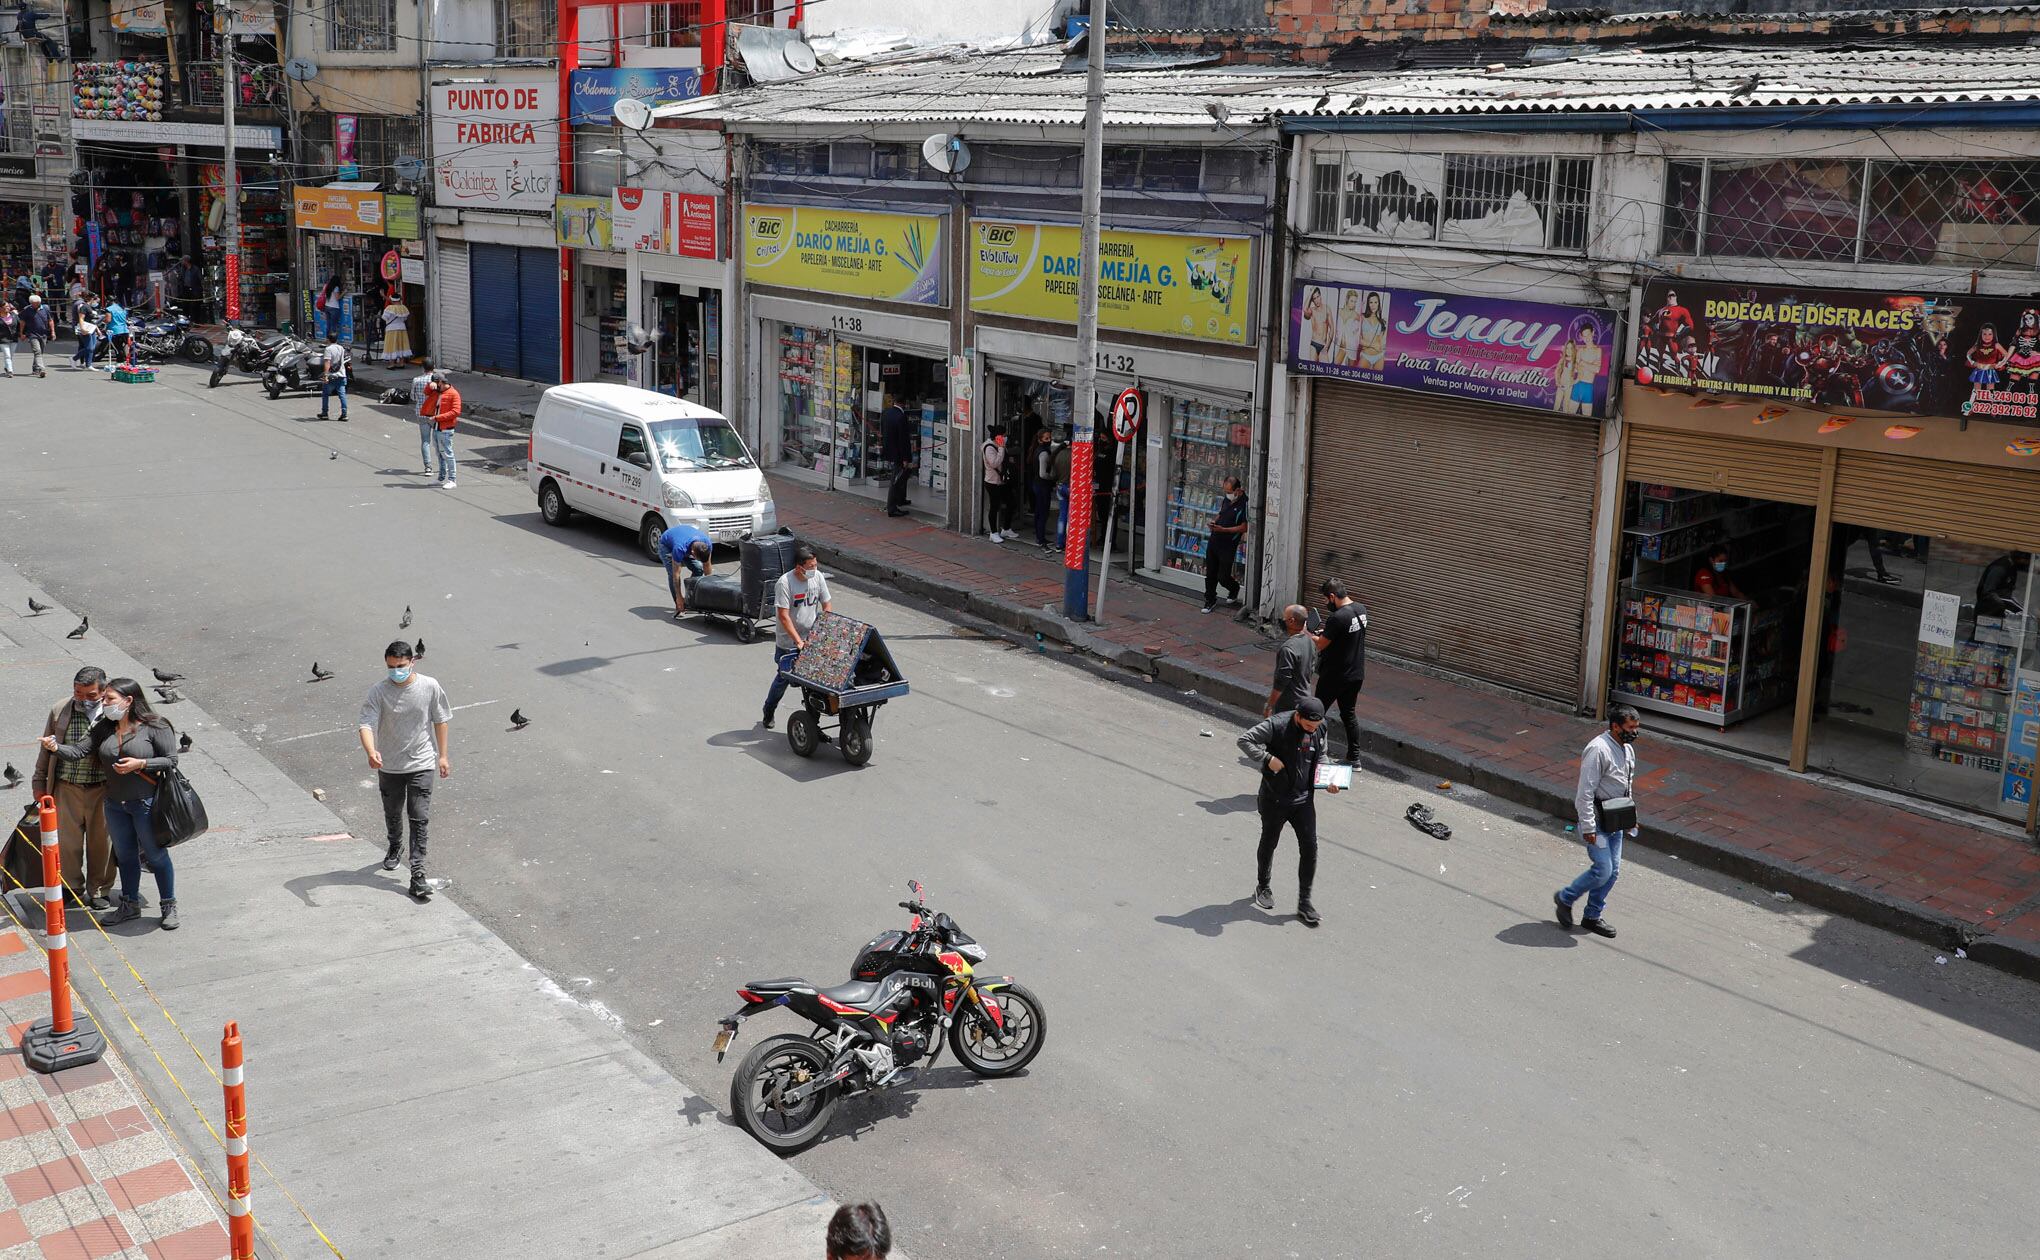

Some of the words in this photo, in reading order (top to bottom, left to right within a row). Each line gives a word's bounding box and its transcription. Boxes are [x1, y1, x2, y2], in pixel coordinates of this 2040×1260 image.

[574, 77, 616, 96] Adornos
[448, 89, 511, 111] PUNTO
[517, 88, 538, 110] DE
[457, 123, 536, 145] FABRICA
[797, 229, 832, 250] DARÍO
[836, 232, 871, 255] MEJÍA
[875, 238, 888, 256] G.
[801, 251, 827, 267] PAPELERÍA
[868, 258, 882, 272] ARTE
[1043, 252, 1081, 276] DARÍ
[1101, 257, 1151, 284] MEJÍA
[1158, 265, 1177, 287] G.
[1045, 279, 1080, 297] PAPELERÍ
[1142, 288, 1162, 305] ARTE
[832, 315, 861, 331] 11-38
[1705, 300, 1775, 323] BODEGA
[1779, 304, 1802, 324] DE
[1804, 306, 1914, 331] DISFRACES
[1395, 299, 1561, 362] Jenny
[1097, 352, 1135, 373] 11-32
[1396, 352, 1431, 372] Para
[1435, 357, 1468, 376] Toda
[1470, 362, 1488, 379] La
[1490, 366, 1550, 388] Familia
[1423, 375, 1447, 387] Ventas
[1449, 380, 1462, 390] por
[1464, 381, 1488, 394] Mayor
[1490, 387, 1495, 396] y
[1497, 387, 1504, 396] al
[1507, 388, 1528, 399] Detal
[1654, 374, 1662, 383] DE
[1663, 375, 1692, 386] FABRICA
[1697, 379, 1723, 390] VENTAS
[1724, 381, 1733, 391] AL
[1734, 383, 1747, 393] POR
[1749, 384, 1773, 395] MAYOR
[1775, 387, 1780, 395] Y
[1781, 387, 1789, 396] AL
[1791, 388, 1813, 398] DETAL
[1994, 391, 2011, 402] 243
[2013, 393, 2026, 403] 03
[2027, 394, 2038, 404] 14
[1973, 403, 1991, 413] 322
[1992, 404, 2010, 415] 392
[2011, 406, 2023, 416] 76
[2024, 407, 2037, 417] 92
[887, 977, 909, 991] Red
[912, 977, 935, 989] Bull
